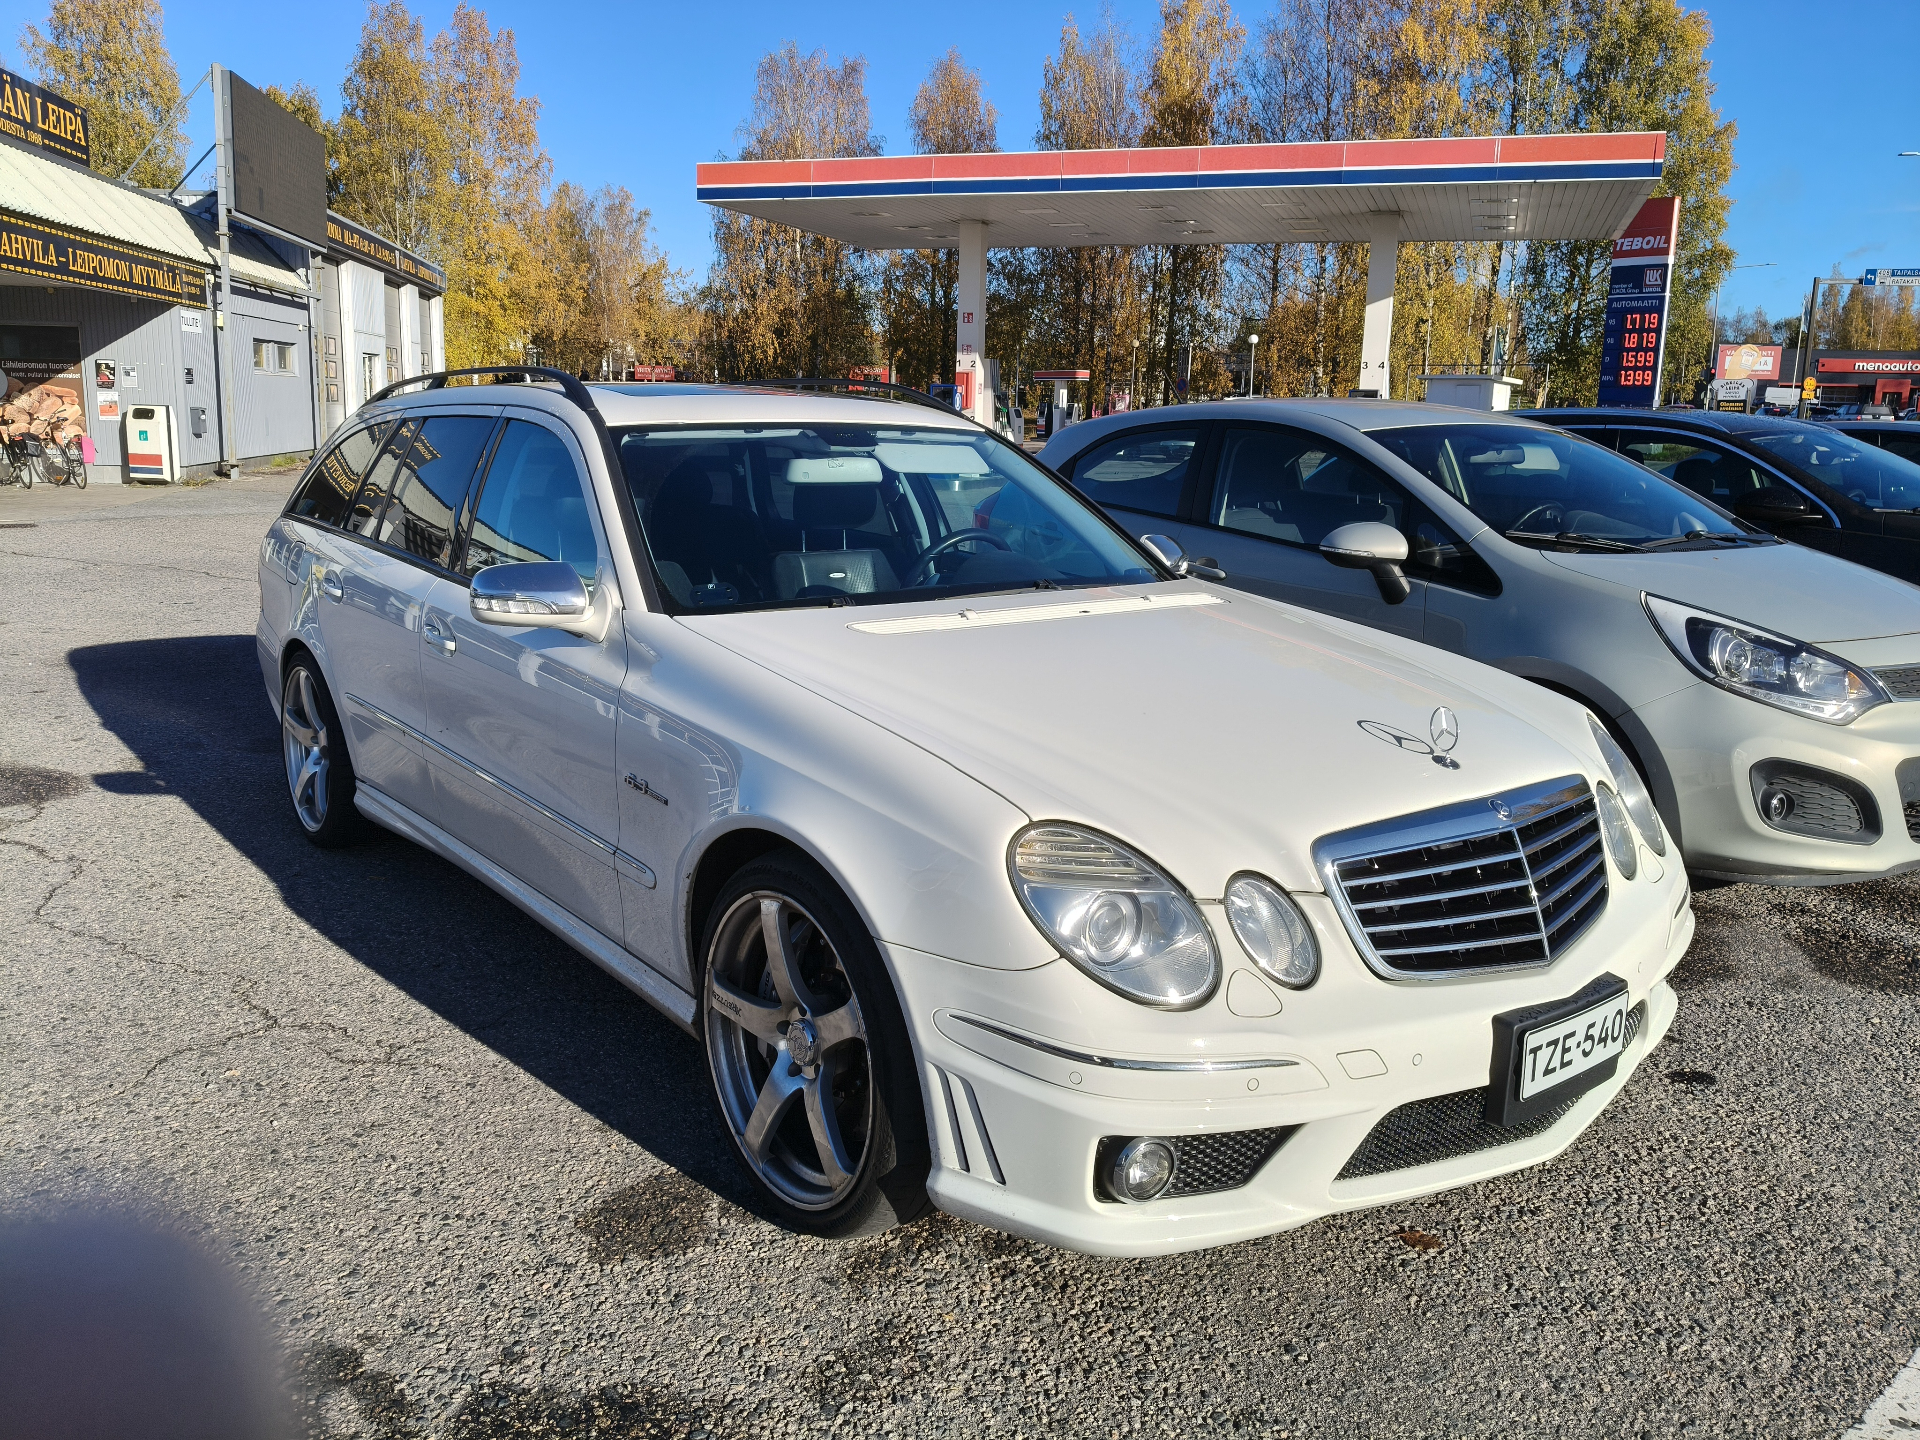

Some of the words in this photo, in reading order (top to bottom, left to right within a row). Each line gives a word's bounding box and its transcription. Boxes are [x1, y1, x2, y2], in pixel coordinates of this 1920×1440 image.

[0, 74, 31, 123] ÄN
[35, 97, 87, 146] LEIPÄ
[0, 117, 26, 139] DESTA
[1616, 235, 1668, 251] TEBOIL
[67, 247, 130, 282] LEIPOMON
[132, 263, 182, 293] MYYMÄLÄ
[1612, 299, 1659, 308] AUTOMAATTI
[1854, 361, 1920, 371] menoauto
[1528, 1008, 1624, 1083] TZE-540
